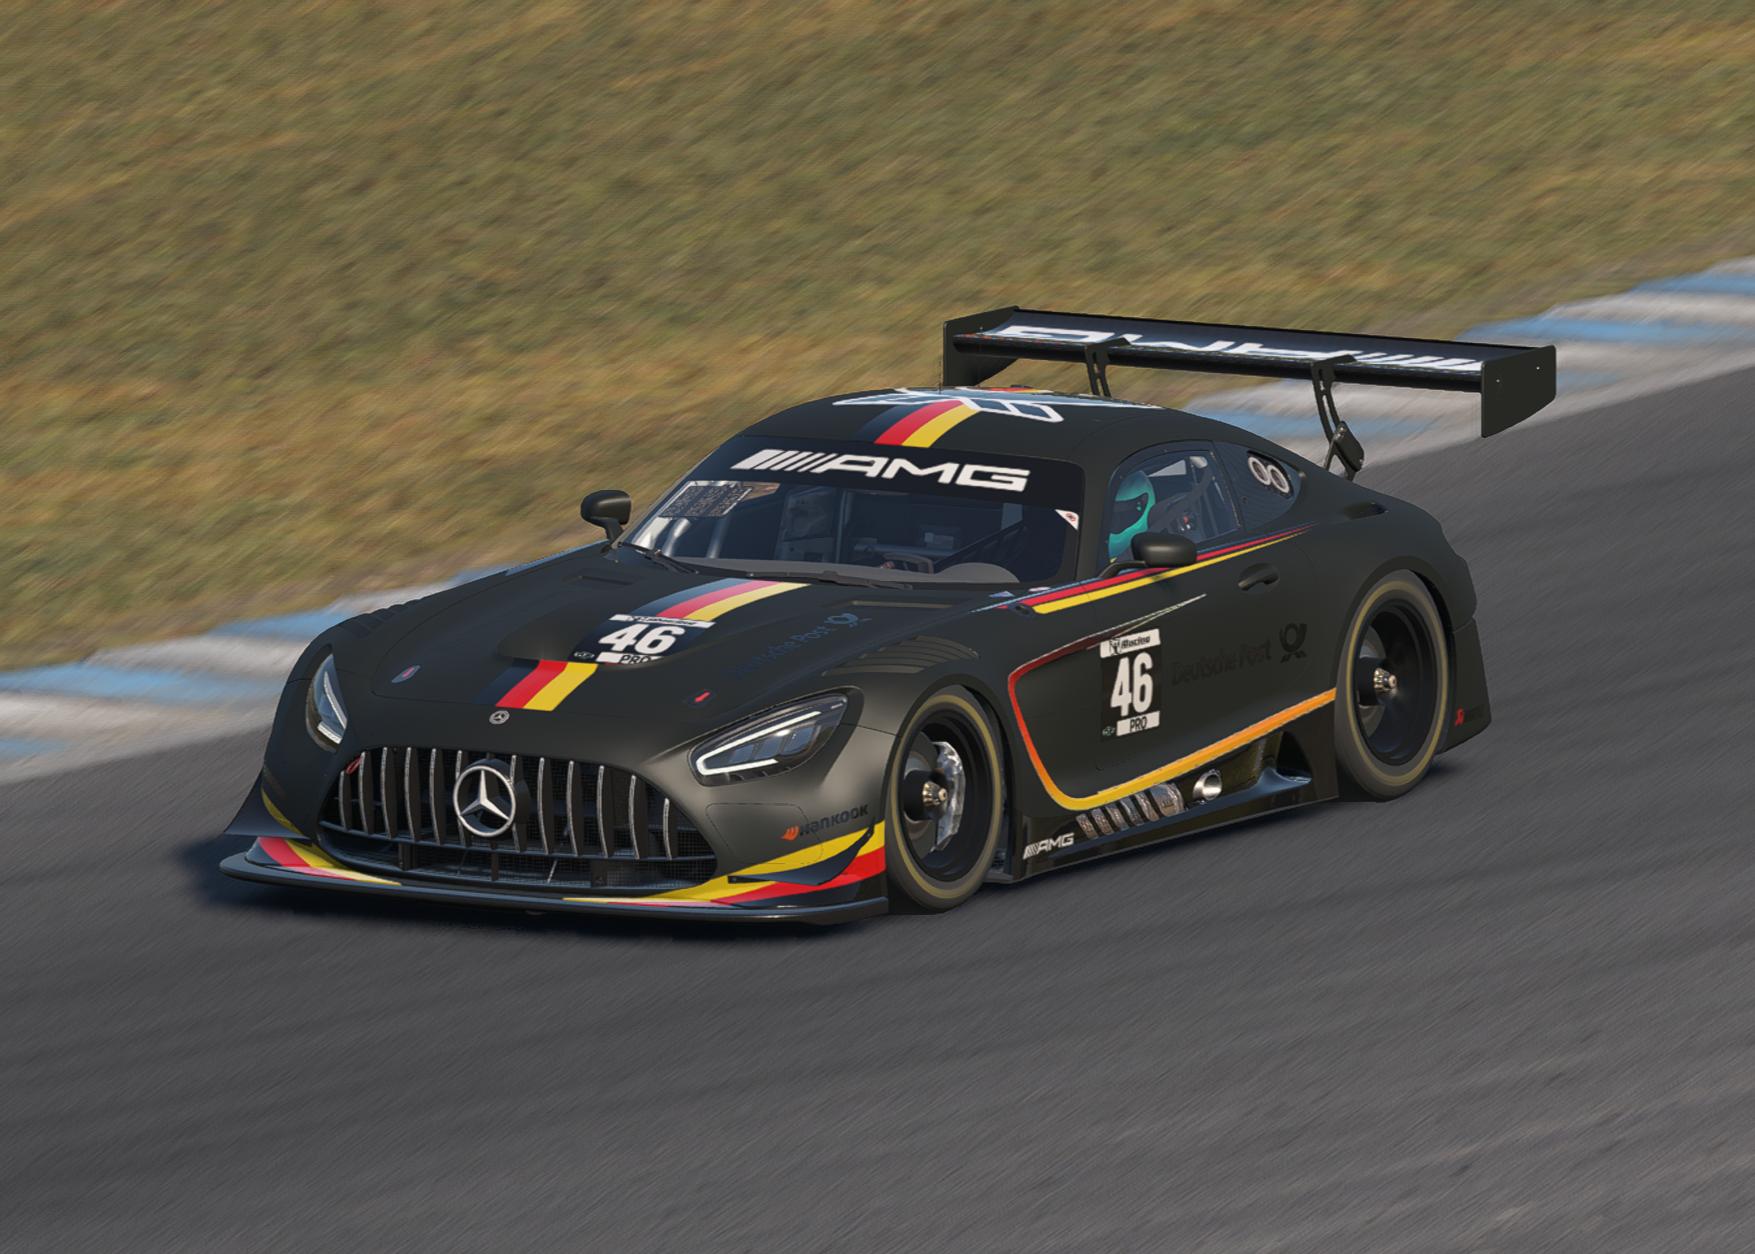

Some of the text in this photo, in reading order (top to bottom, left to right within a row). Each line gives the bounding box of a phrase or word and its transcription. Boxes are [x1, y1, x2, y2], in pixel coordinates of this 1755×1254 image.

[814, 454, 1031, 492] AMG
[597, 623, 686, 655] 46
[619, 654, 651, 664] PRO
[1110, 651, 1154, 717] 46
[1130, 716, 1148, 732] PRO
[1036, 832, 1075, 856] AMG
